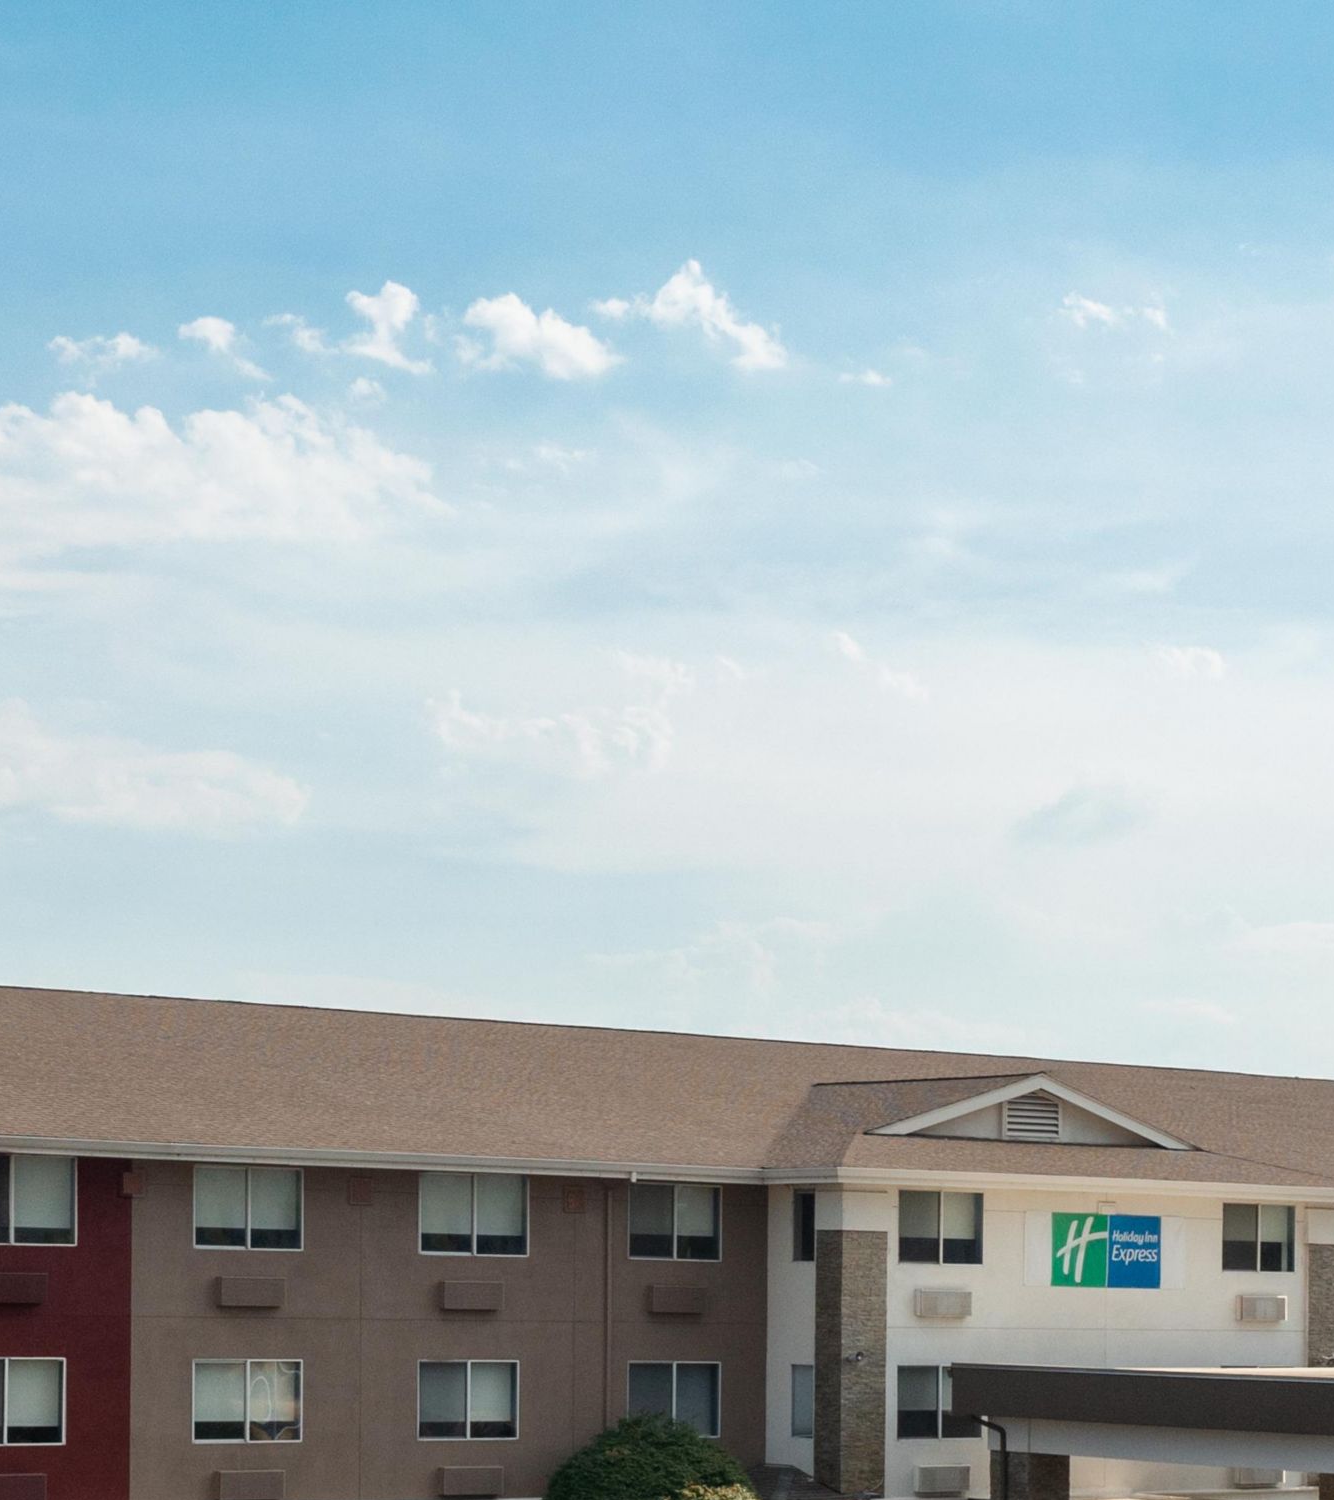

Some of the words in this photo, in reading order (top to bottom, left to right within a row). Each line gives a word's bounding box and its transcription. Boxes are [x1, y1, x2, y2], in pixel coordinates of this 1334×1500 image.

[1112, 1230, 1144, 1245] Holiday
[1145, 1231, 1158, 1242] Inn
[1112, 1245, 1158, 1266] Express
